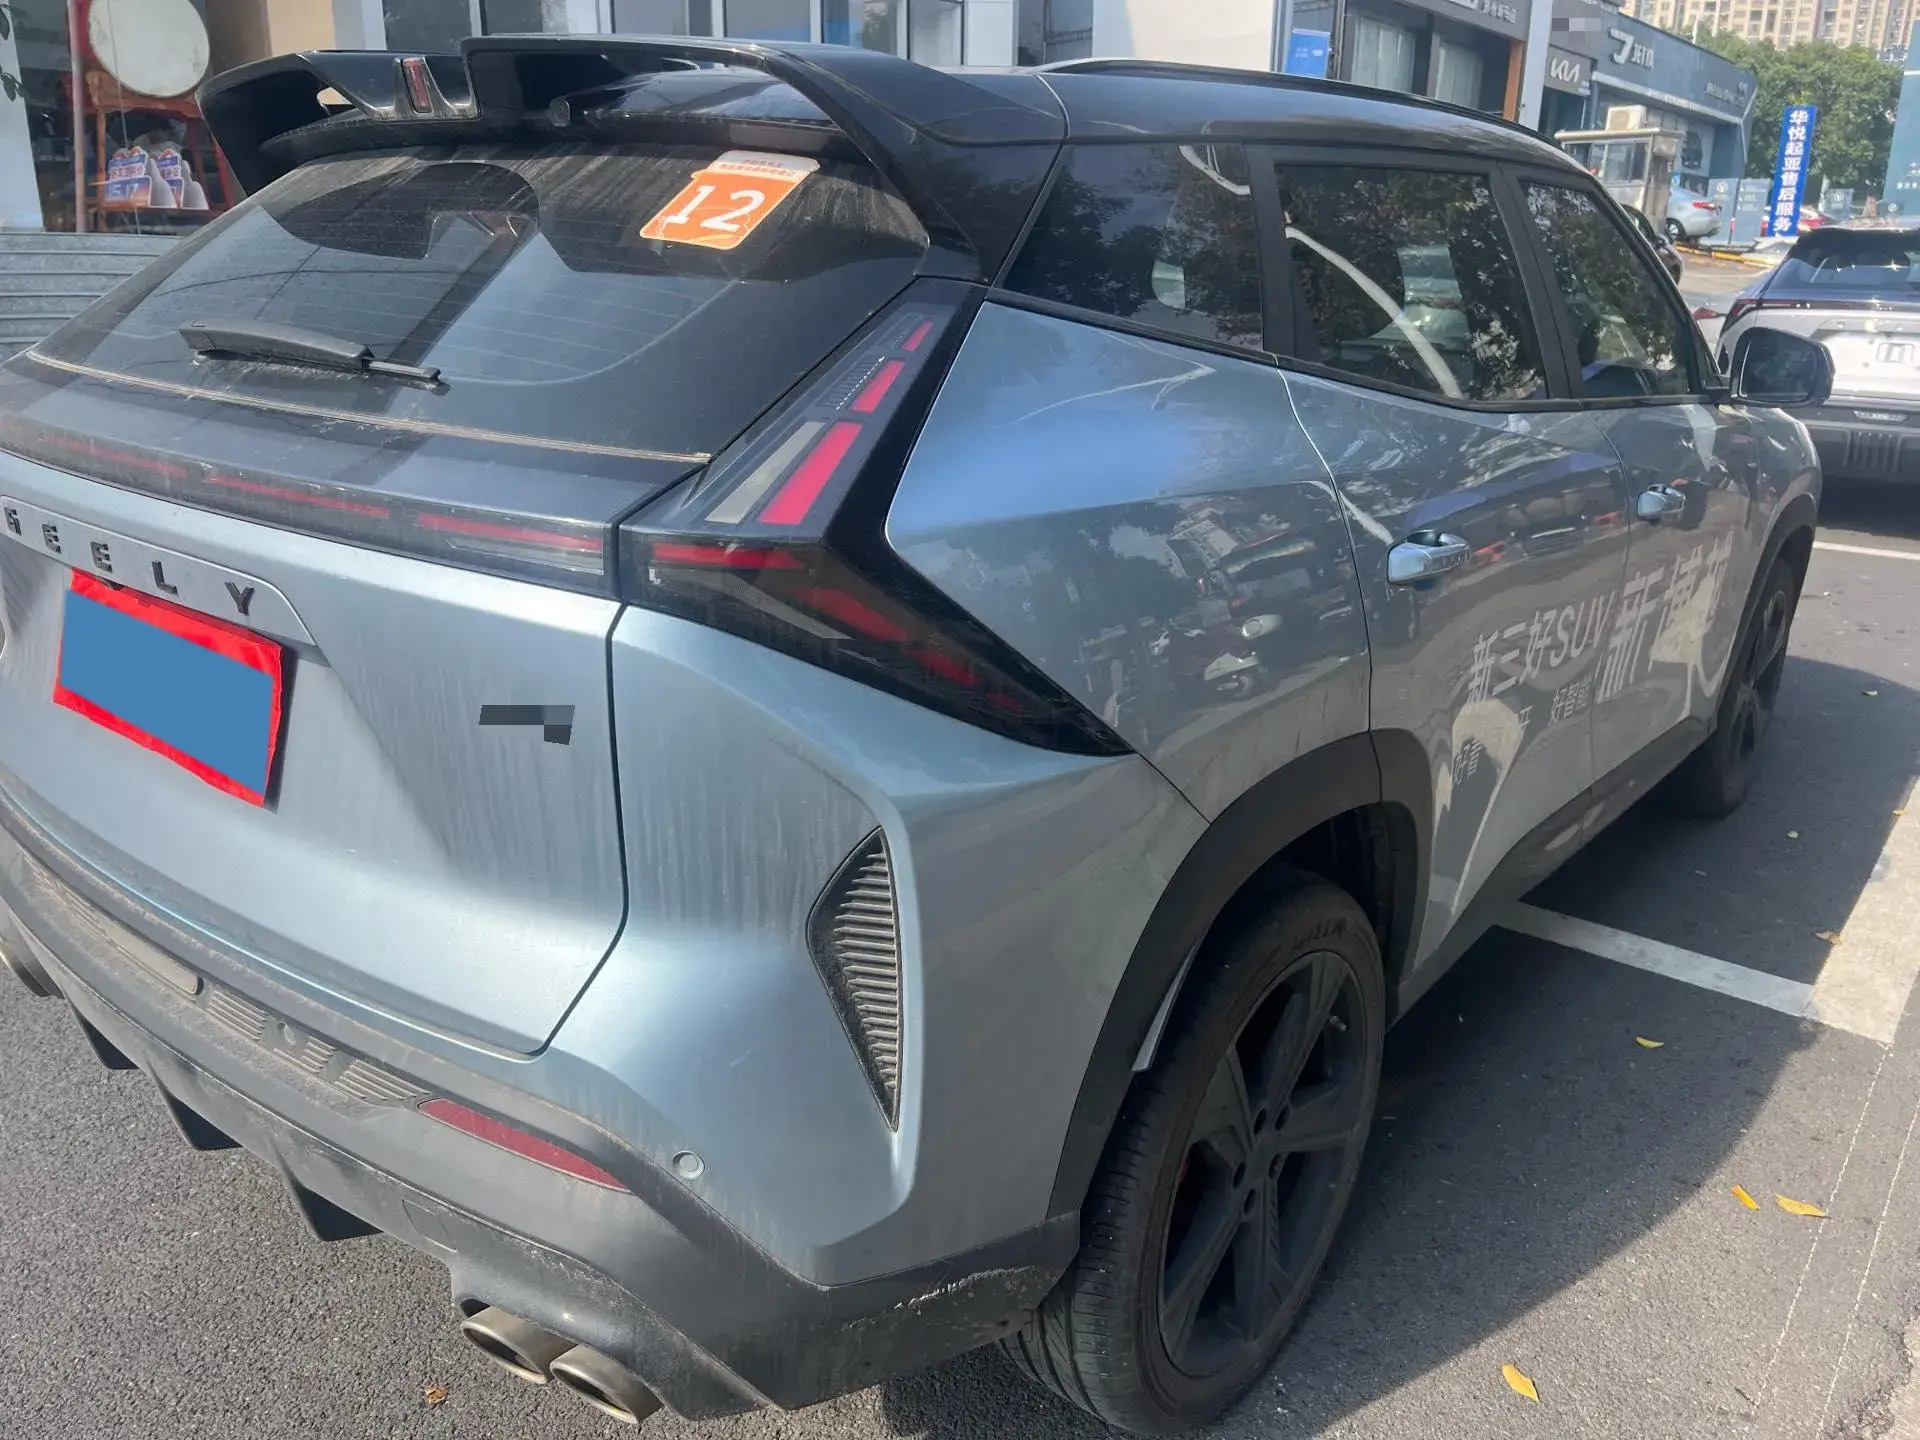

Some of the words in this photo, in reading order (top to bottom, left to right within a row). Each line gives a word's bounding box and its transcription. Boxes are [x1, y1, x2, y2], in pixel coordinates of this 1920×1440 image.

[667, 185, 766, 233] 12
[1773, 109, 1809, 232] 华悦起亚售后服务
[3, 506, 256, 617] GEELY
